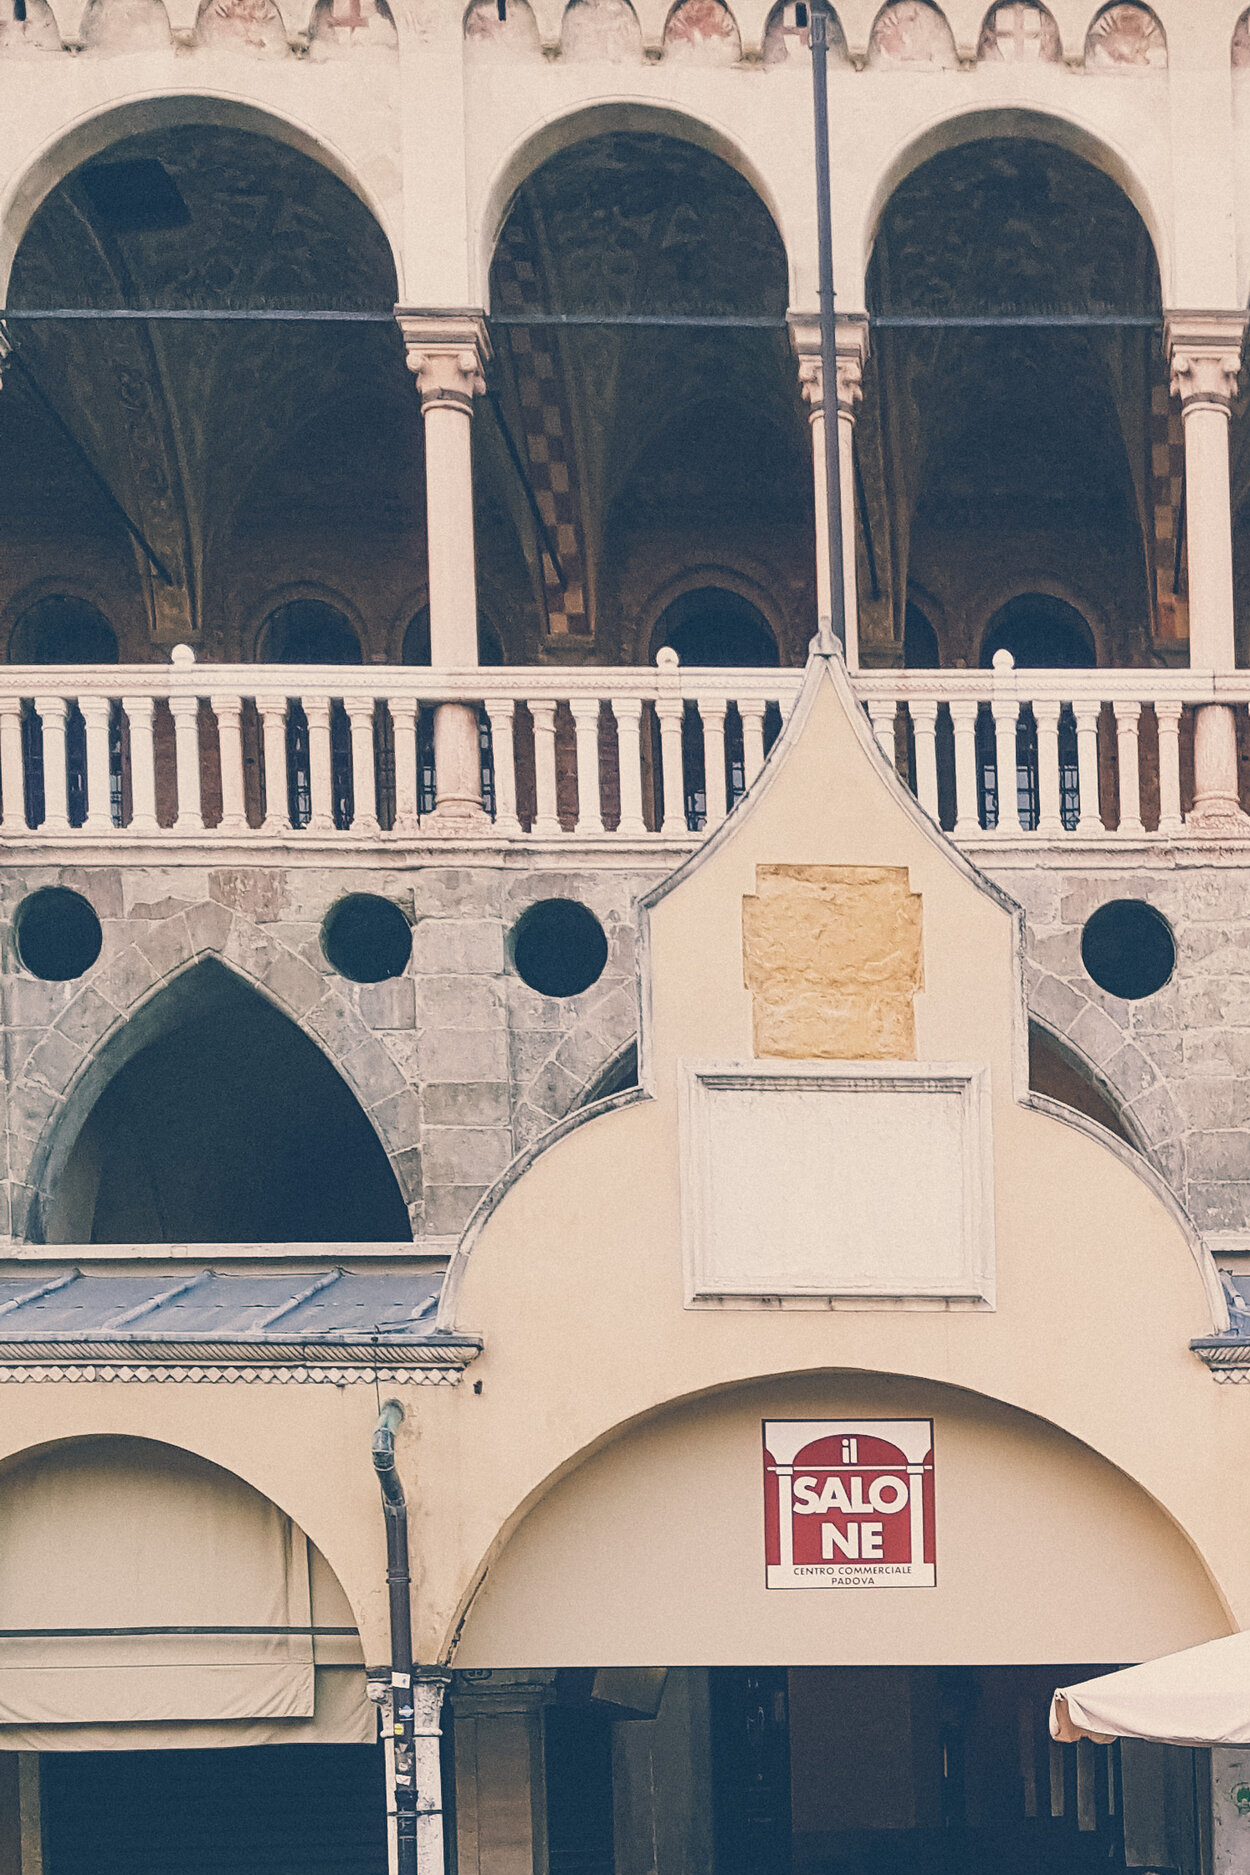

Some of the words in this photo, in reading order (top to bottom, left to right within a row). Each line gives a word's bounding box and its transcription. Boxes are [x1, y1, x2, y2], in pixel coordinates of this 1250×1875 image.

[842, 1438, 858, 1464] il
[793, 1475, 909, 1515] SALO
[821, 1522, 884, 1560] NE
[793, 1566, 835, 1576] CENTRO
[838, 1565, 912, 1575] COMMERCIALE
[831, 1577, 875, 1586] PADOVA
